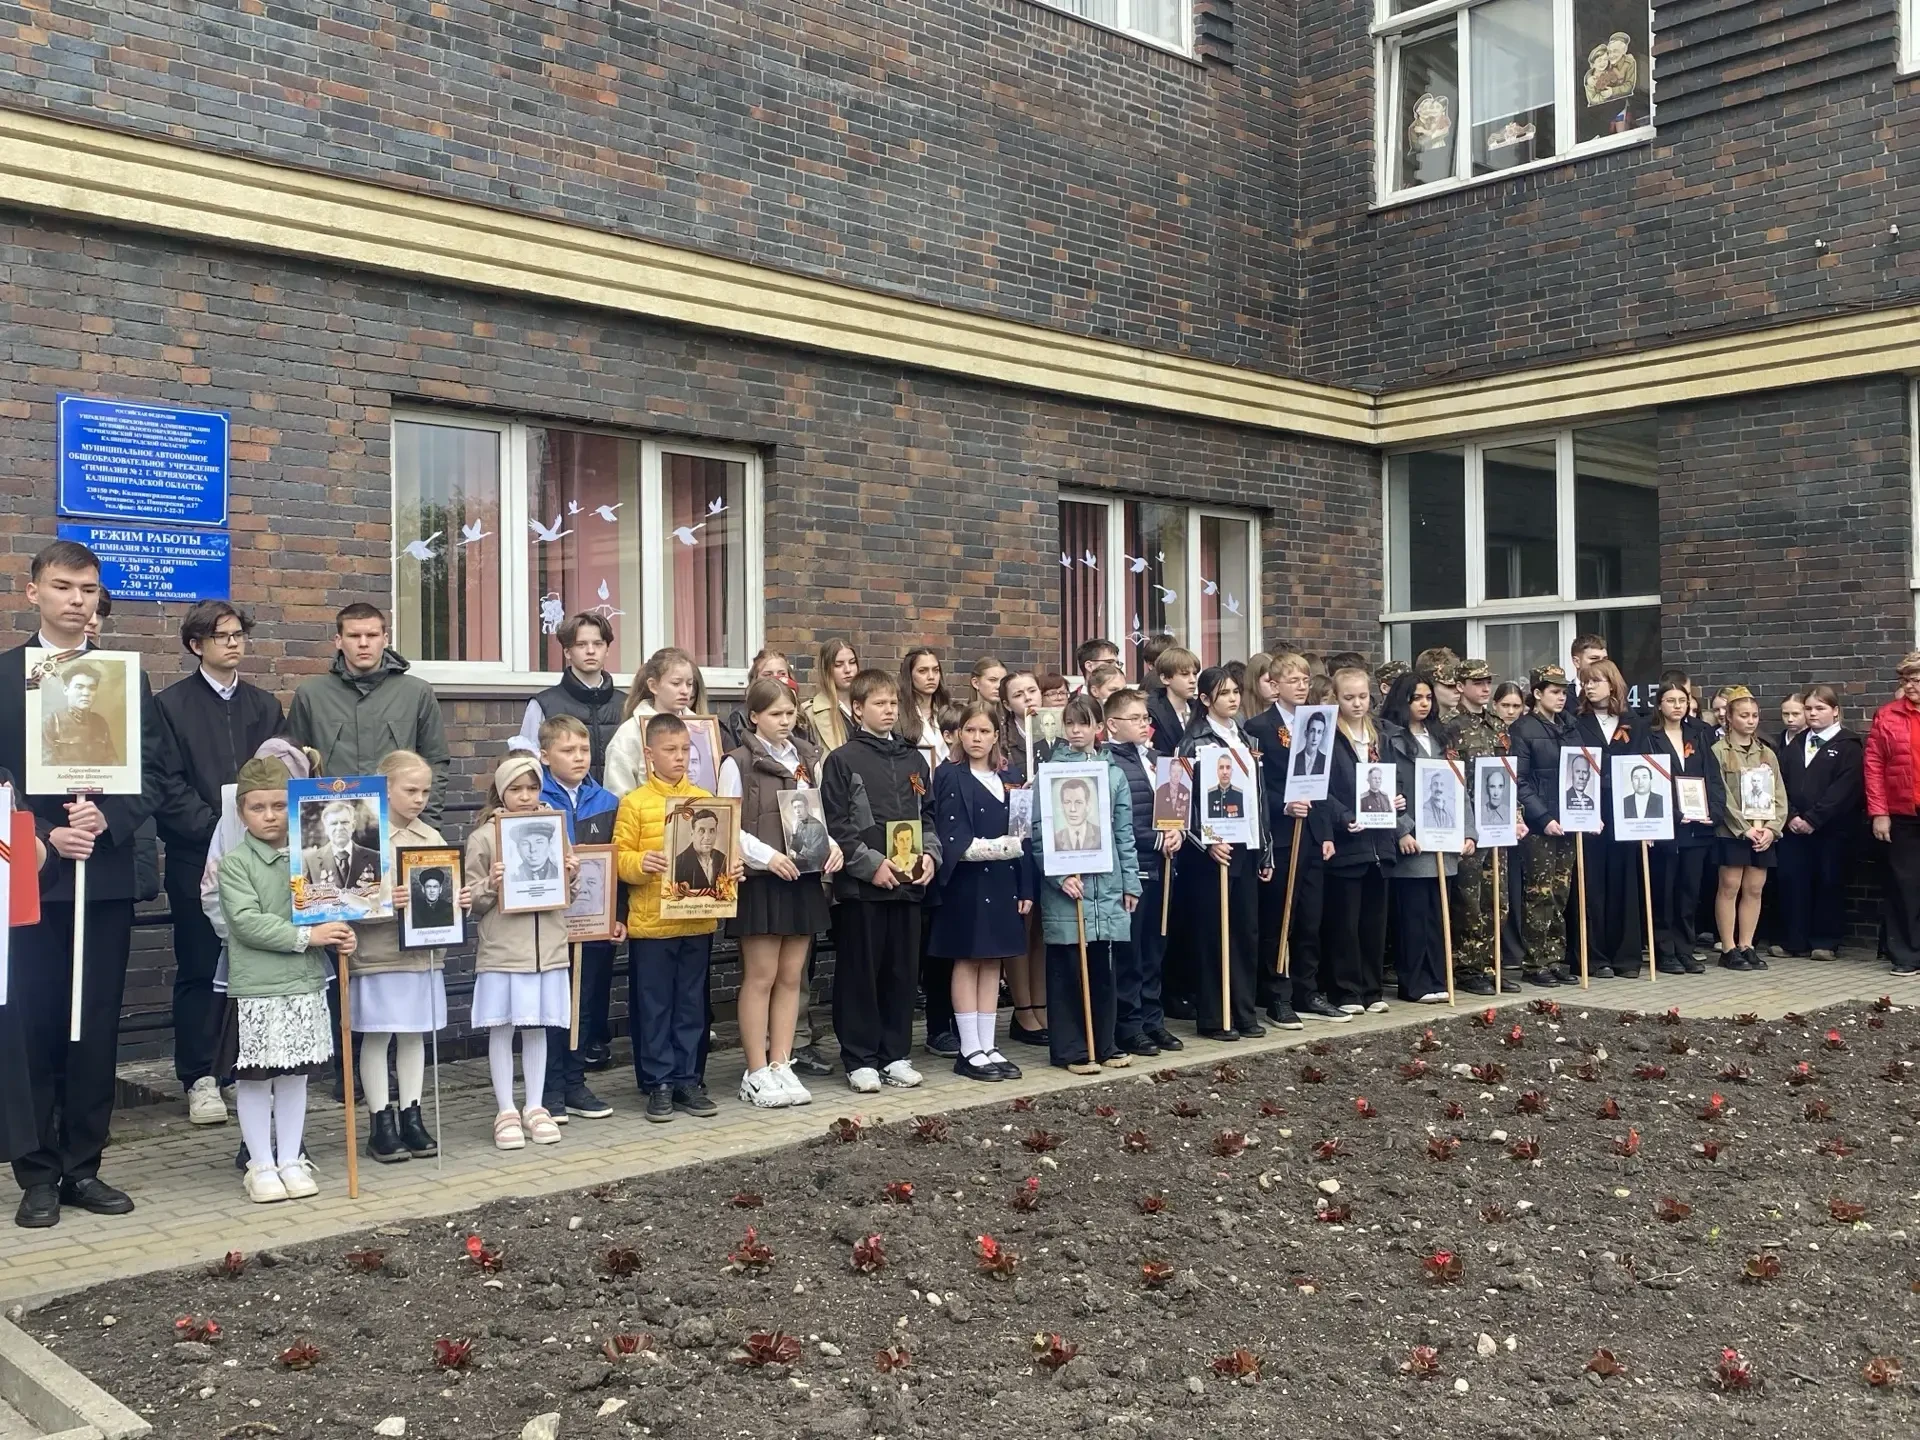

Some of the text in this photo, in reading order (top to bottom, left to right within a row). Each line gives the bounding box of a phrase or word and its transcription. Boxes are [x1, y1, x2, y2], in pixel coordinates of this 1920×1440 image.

[82, 444, 208, 462] МУНИЦИПАЛЬНОЕ АВТОНОМНОЕ
[68, 452, 220, 473] ОБЩЕОБРАЗОВАТЕЛЬНОЕ УЧРЕЖДЕНИЕ
[81, 464, 128, 474] «ГИМНАЗИЯ
[153, 471, 208, 482] ЧЕРНЯХОВСКА
[86, 474, 204, 490] КАЛИНИНГРАДСКОЙ ОБЛАСТИ»
[90, 529, 201, 545] РЕЖИМ РАБОТЫ
[90, 542, 140, 552] «ГИМНАЗИЯ
[165, 548, 225, 558] ЧЕРНЯХОВСКА»
[149, 565, 174, 574] 20.00
